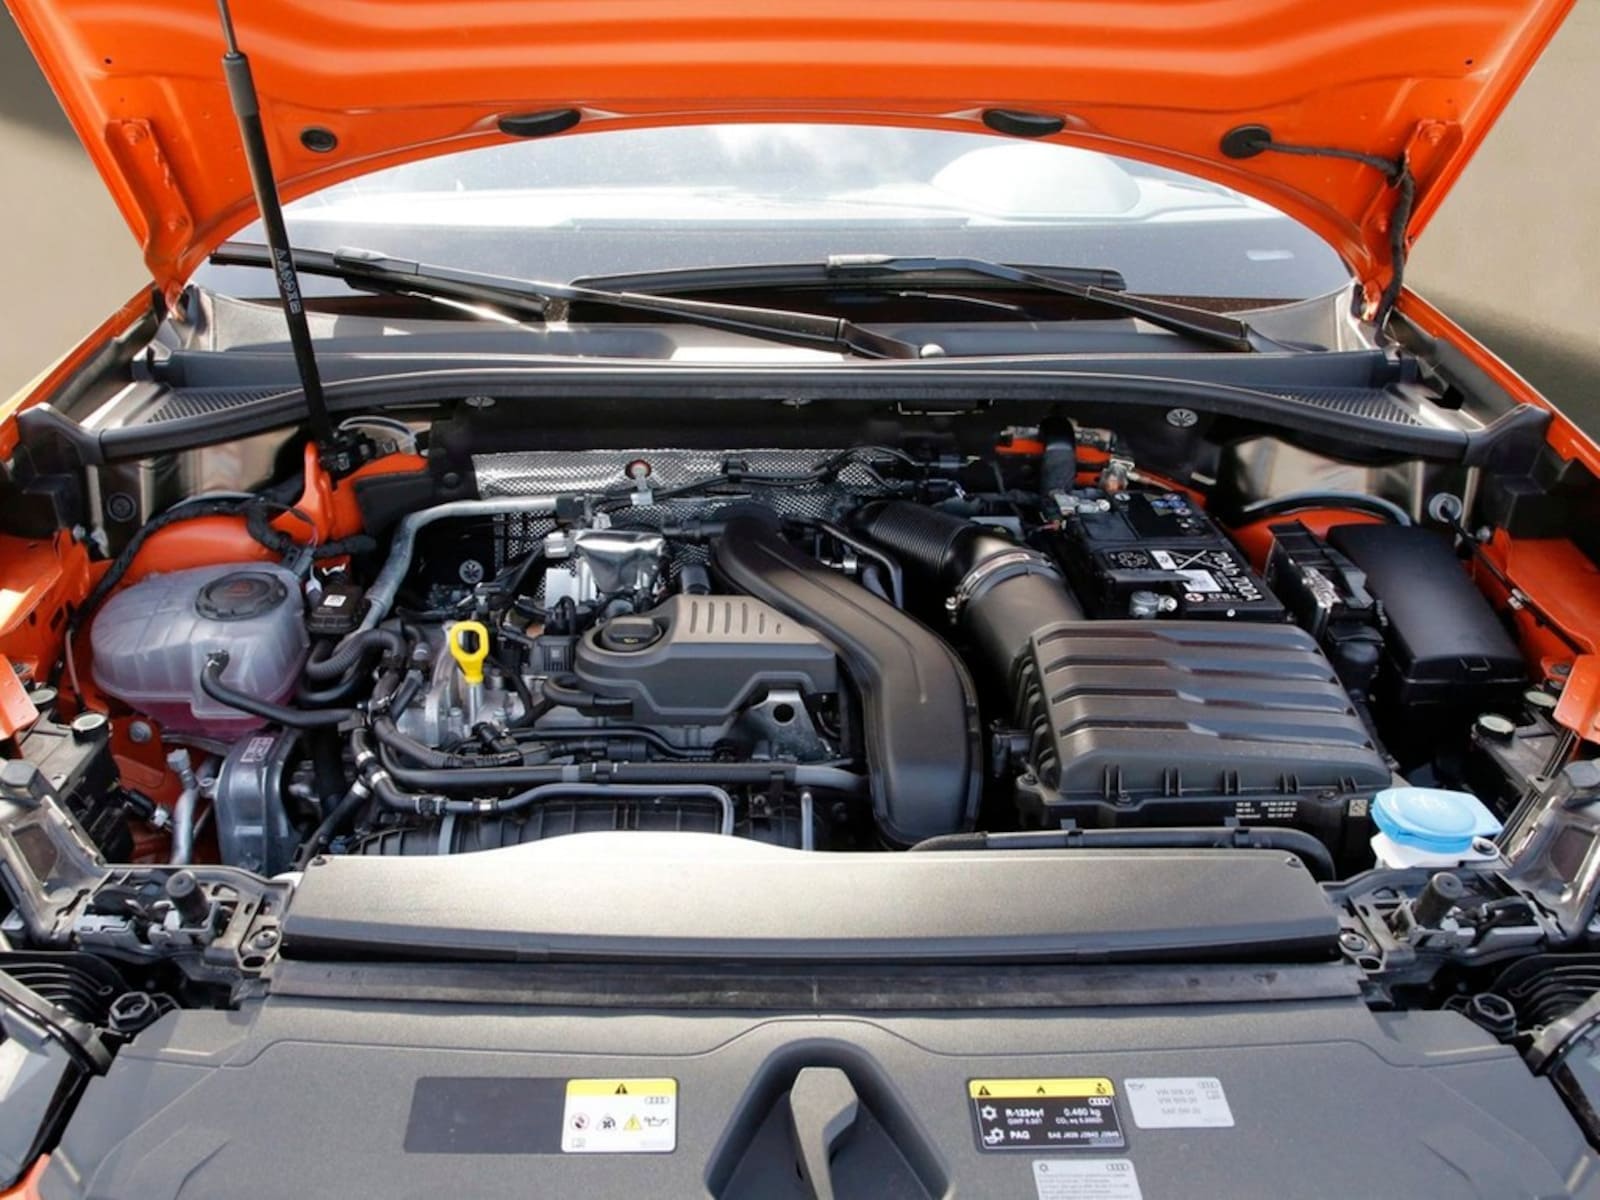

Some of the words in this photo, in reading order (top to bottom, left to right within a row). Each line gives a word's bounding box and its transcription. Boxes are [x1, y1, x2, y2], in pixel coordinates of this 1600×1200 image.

[1230, 576, 1263, 601] 700A
[1090, 1107, 1102, 1119] kg
[1010, 1130, 1031, 1140] PAG
